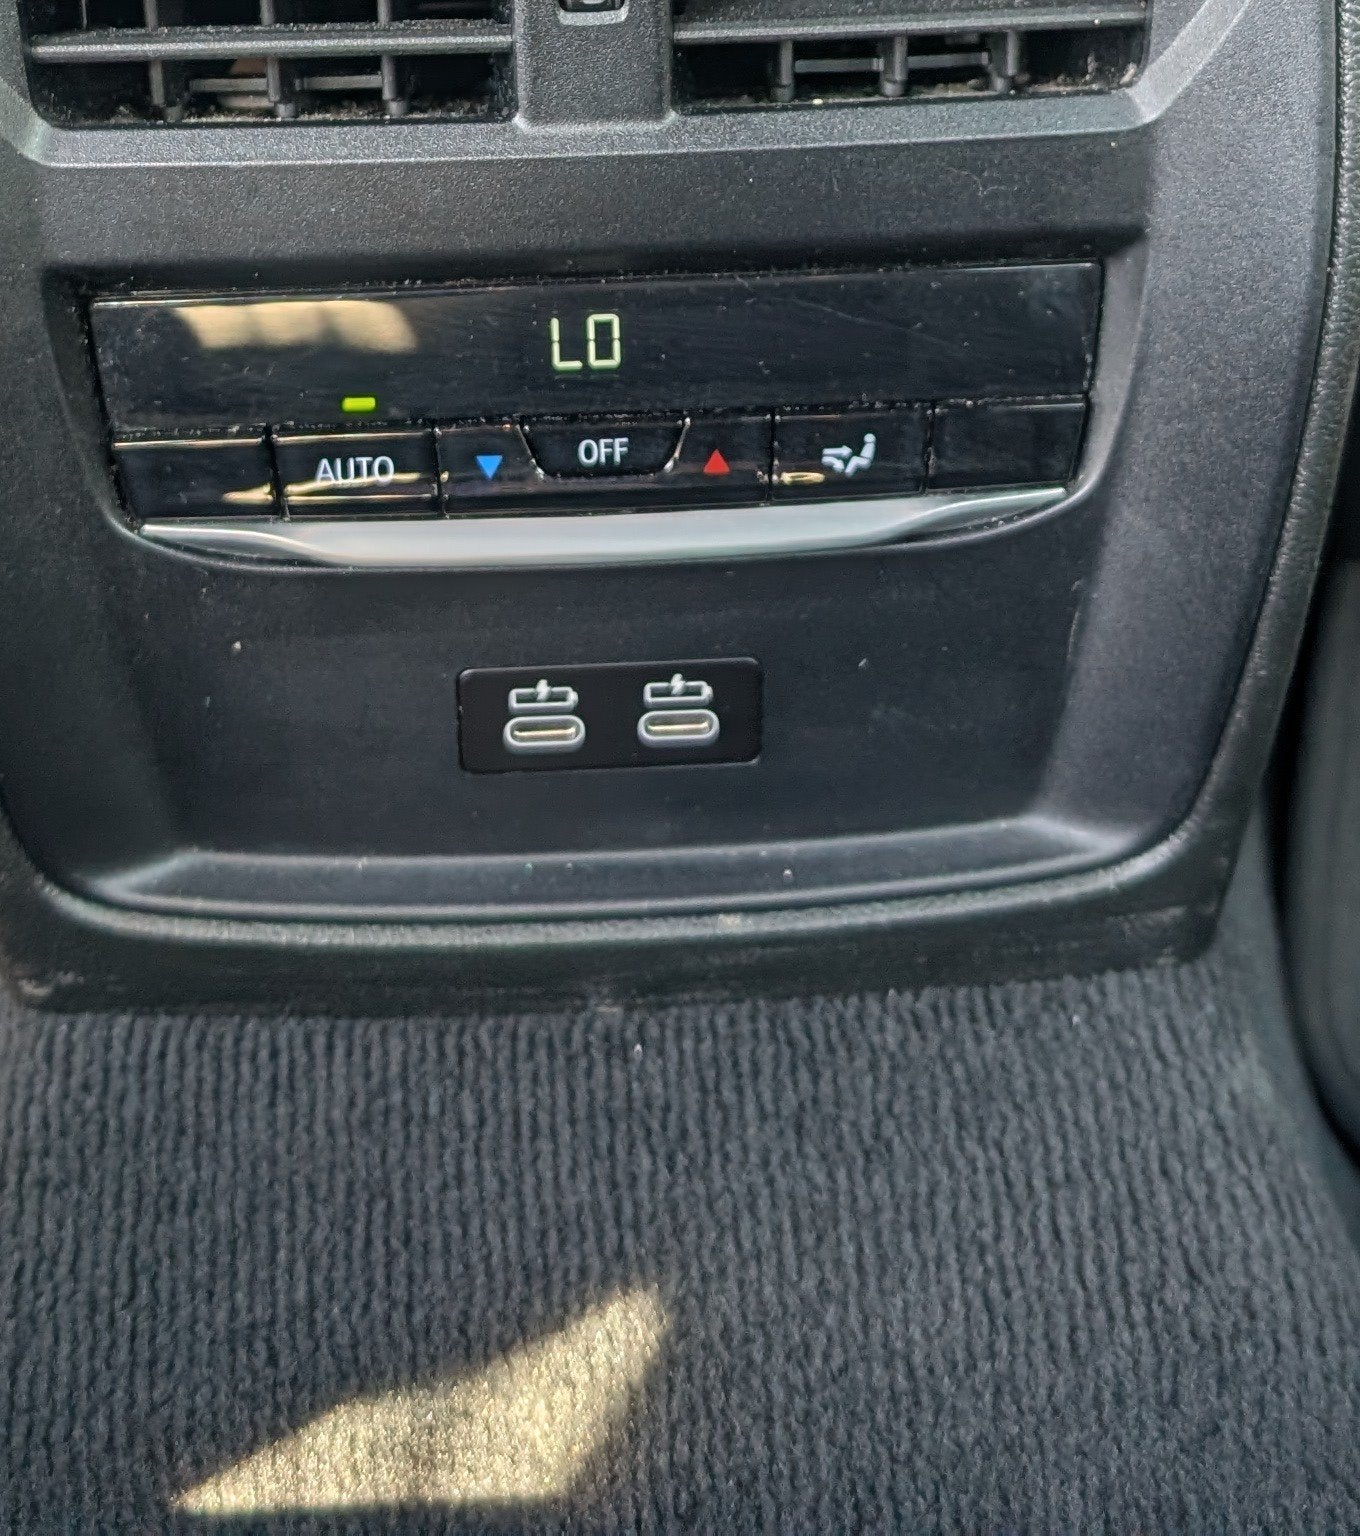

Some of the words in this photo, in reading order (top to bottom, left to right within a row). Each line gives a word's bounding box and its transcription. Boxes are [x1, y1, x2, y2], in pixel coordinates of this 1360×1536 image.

[550, 314, 621, 371] LO
[577, 437, 629, 466] OFF
[314, 455, 395, 486] AUTO
